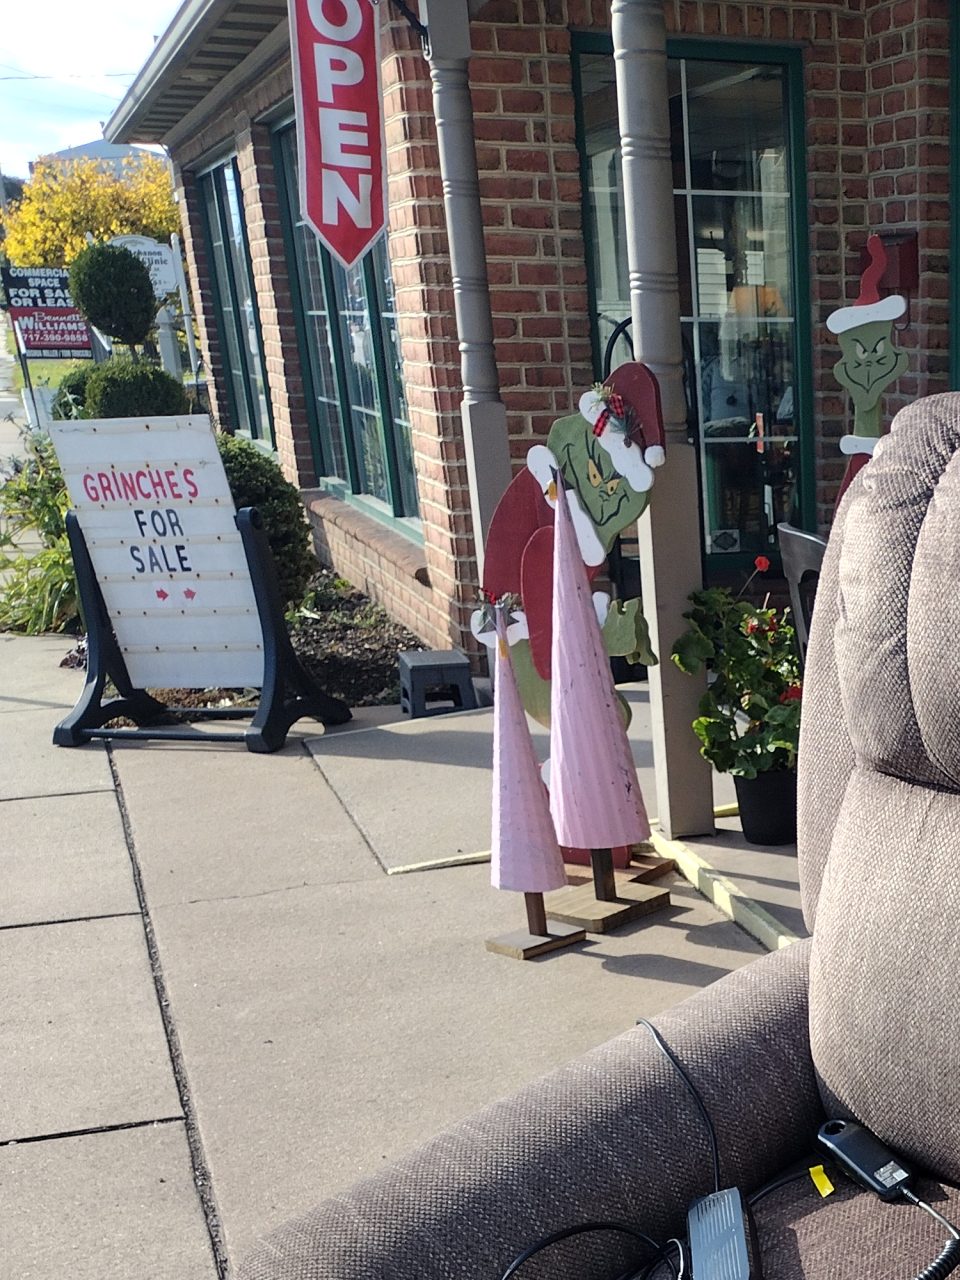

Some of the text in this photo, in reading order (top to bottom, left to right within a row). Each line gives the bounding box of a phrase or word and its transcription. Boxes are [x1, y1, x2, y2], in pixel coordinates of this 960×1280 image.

[307, 0, 373, 229] OPEN
[9, 268, 71, 278] COMMERCIA
[27, 278, 61, 288] SPACE
[9, 288, 71, 298] FOR SAL
[10, 298, 74, 308] OR LEAS
[17, 316, 87, 330] WILLIAMS
[83, 468, 199, 502] GRINCHES
[133, 508, 184, 538] FOR
[129, 544, 192, 573] SALE
